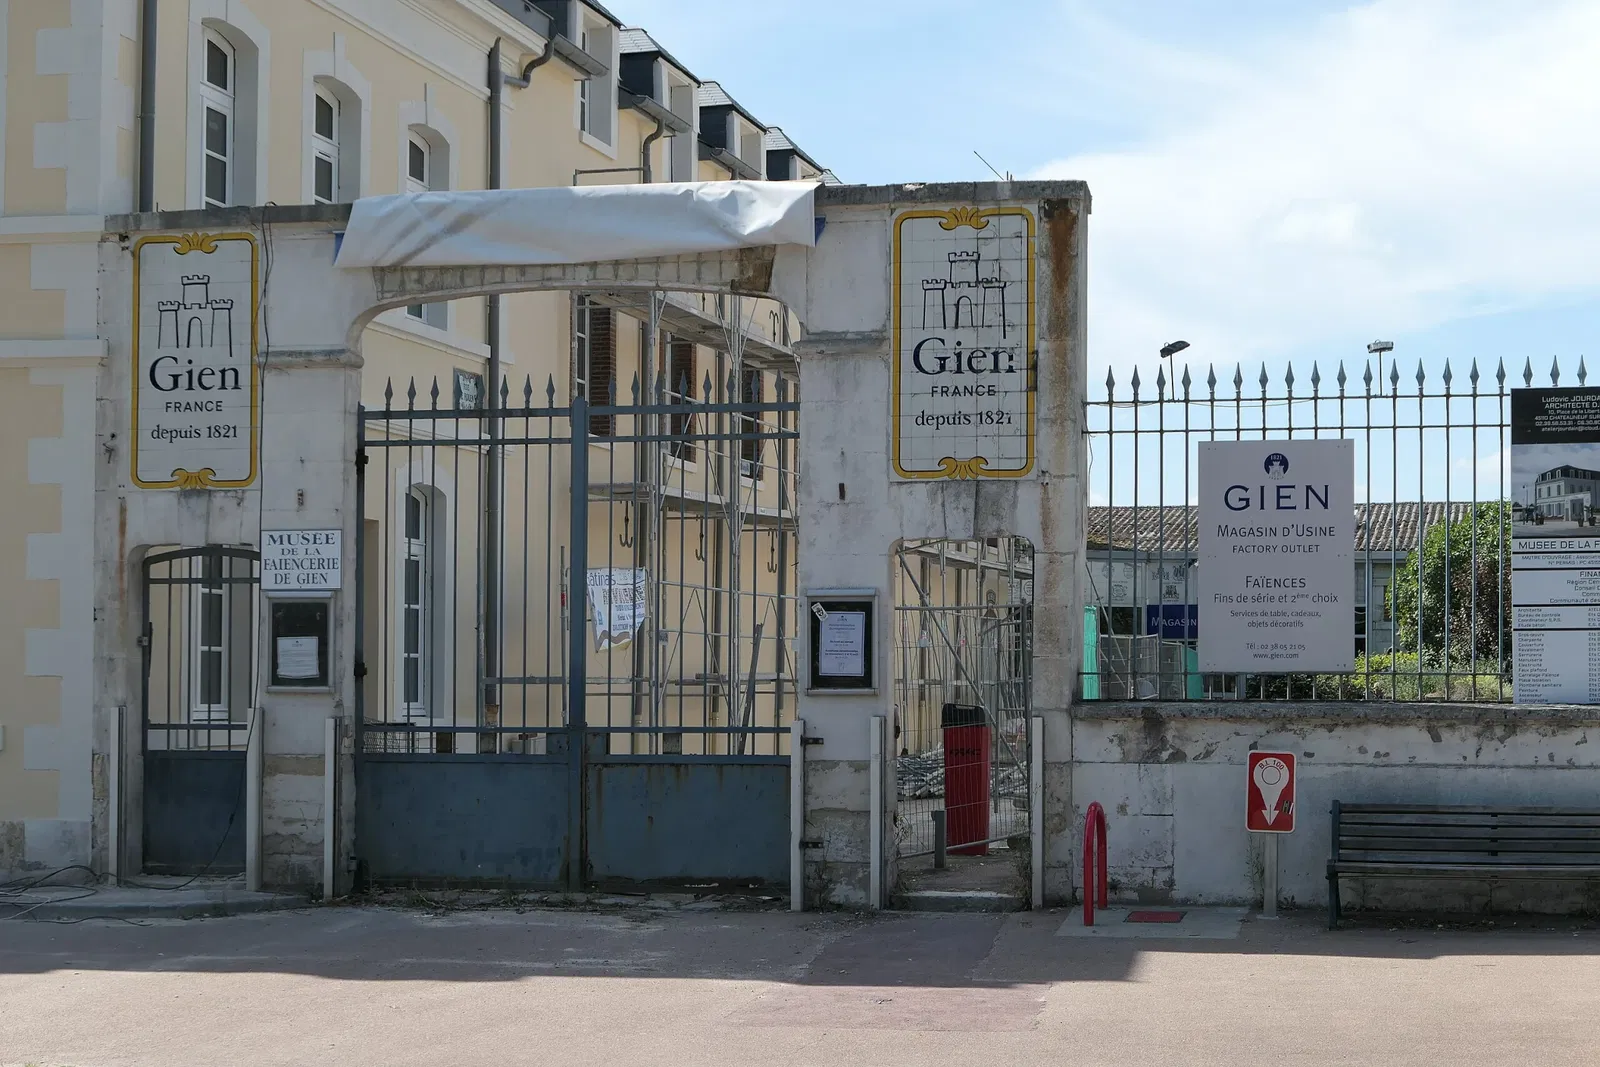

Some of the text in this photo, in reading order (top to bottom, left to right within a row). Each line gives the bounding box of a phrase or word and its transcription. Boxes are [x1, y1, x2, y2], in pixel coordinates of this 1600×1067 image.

[912, 337, 1017, 375] Gien
[149, 355, 242, 392] Gien
[931, 384, 996, 397] FRANCE
[165, 400, 223, 413] FRANCE
[915, 409, 971, 431] depuis
[151, 424, 238, 444] depuis 1821
[1224, 484, 1330, 512] GIEN
[267, 532, 335, 546] MUSEE
[1518, 541, 1557, 550] MUSEE
[1560, 540, 1575, 549] DE
[1578, 540, 1591, 549] LA
[281, 548, 322, 556] DE LA
[1232, 544, 1321, 554] FACTORY OUTLET
[263, 557, 340, 571] FAIENCERIE
[274, 572, 328, 585] DE GIEN
[1245, 575, 1307, 589] FAÏENCES
[1213, 593, 1234, 604] Fins
[1236, 593, 1247, 604] de
[1251, 593, 1275, 604] série
[1278, 594, 1288, 604] et
[1311, 592, 1339, 603] choix
[1230, 609, 1322, 619] Services de table, cadeaux,
[1247, 619, 1304, 630] objets décoratifs
[1246, 642, 1256, 651] Tél
[1271, 643, 1279, 651] 38
[1252, 652, 1300, 660] www.gien.com
[1272, 759, 1285, 770] 100
